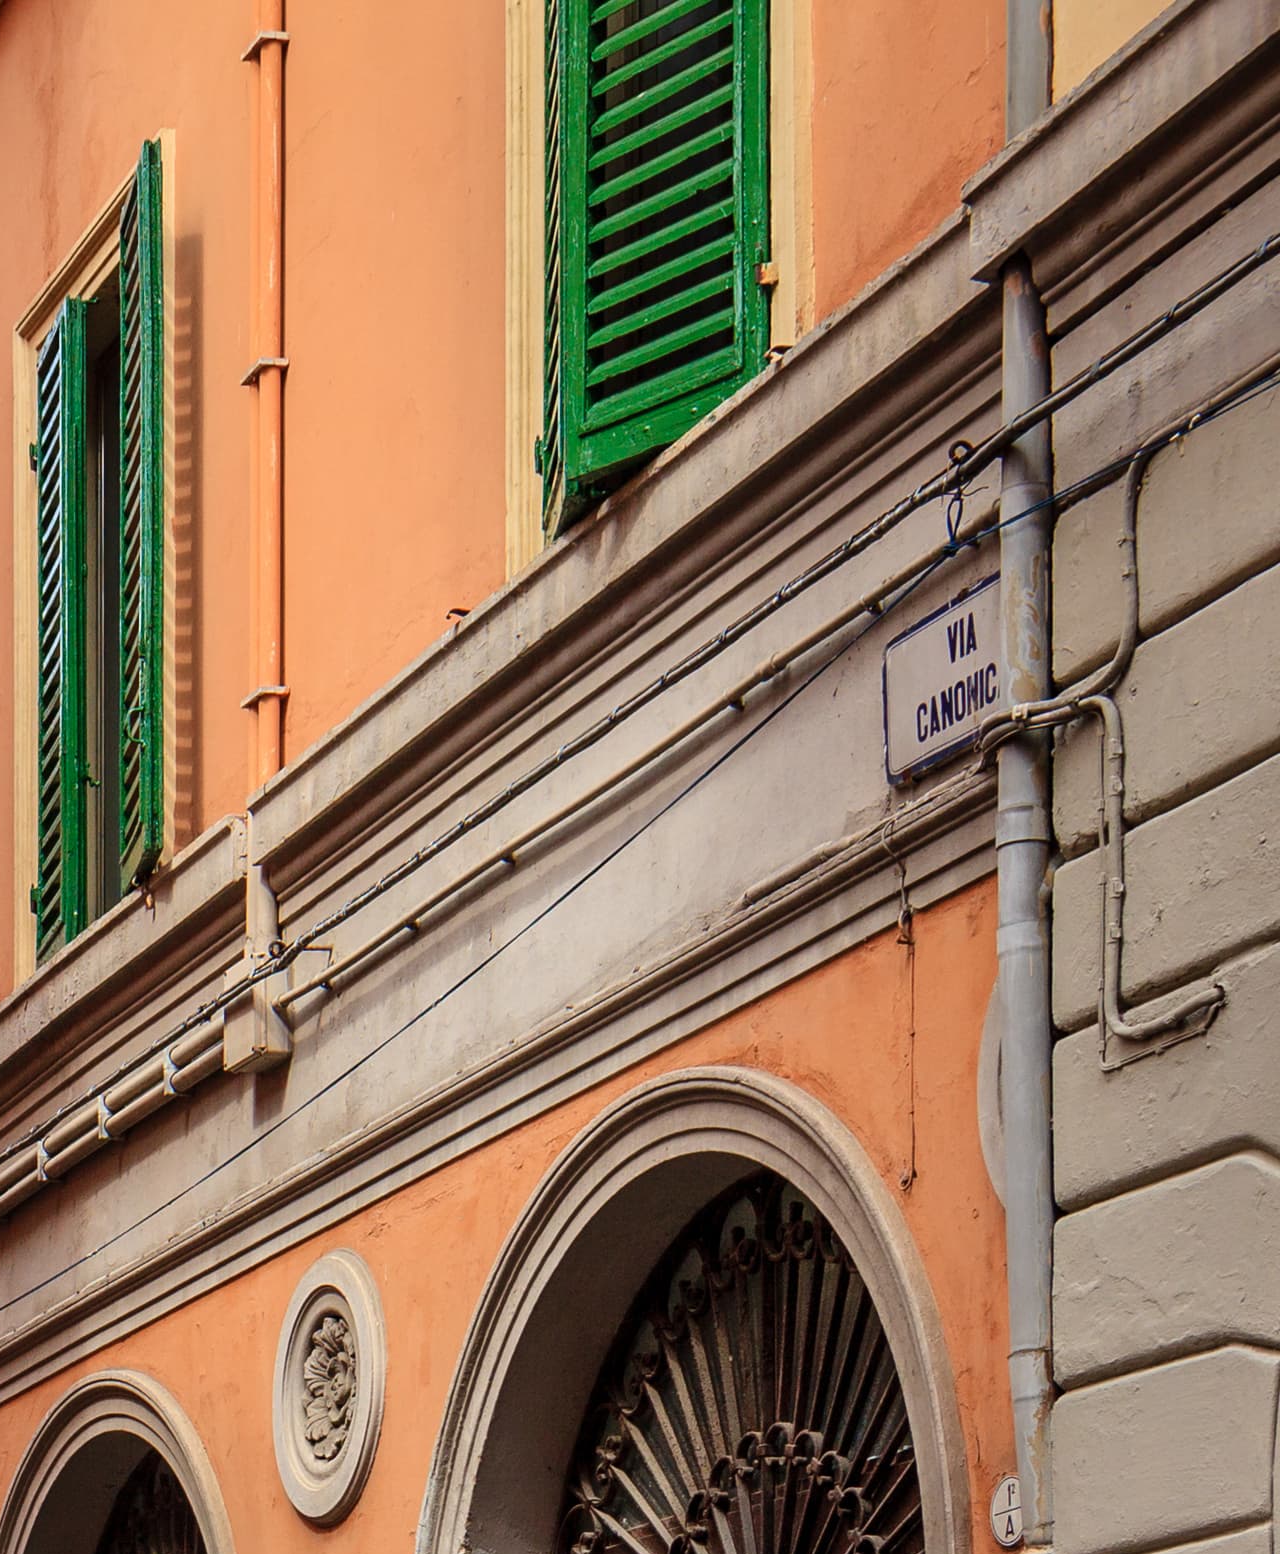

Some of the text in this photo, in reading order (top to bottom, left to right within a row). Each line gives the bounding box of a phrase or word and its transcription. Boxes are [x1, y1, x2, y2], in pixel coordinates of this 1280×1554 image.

[947, 612, 977, 664] VIA
[916, 662, 1000, 743] CANONIC
[1005, 1514, 1015, 1539] A
